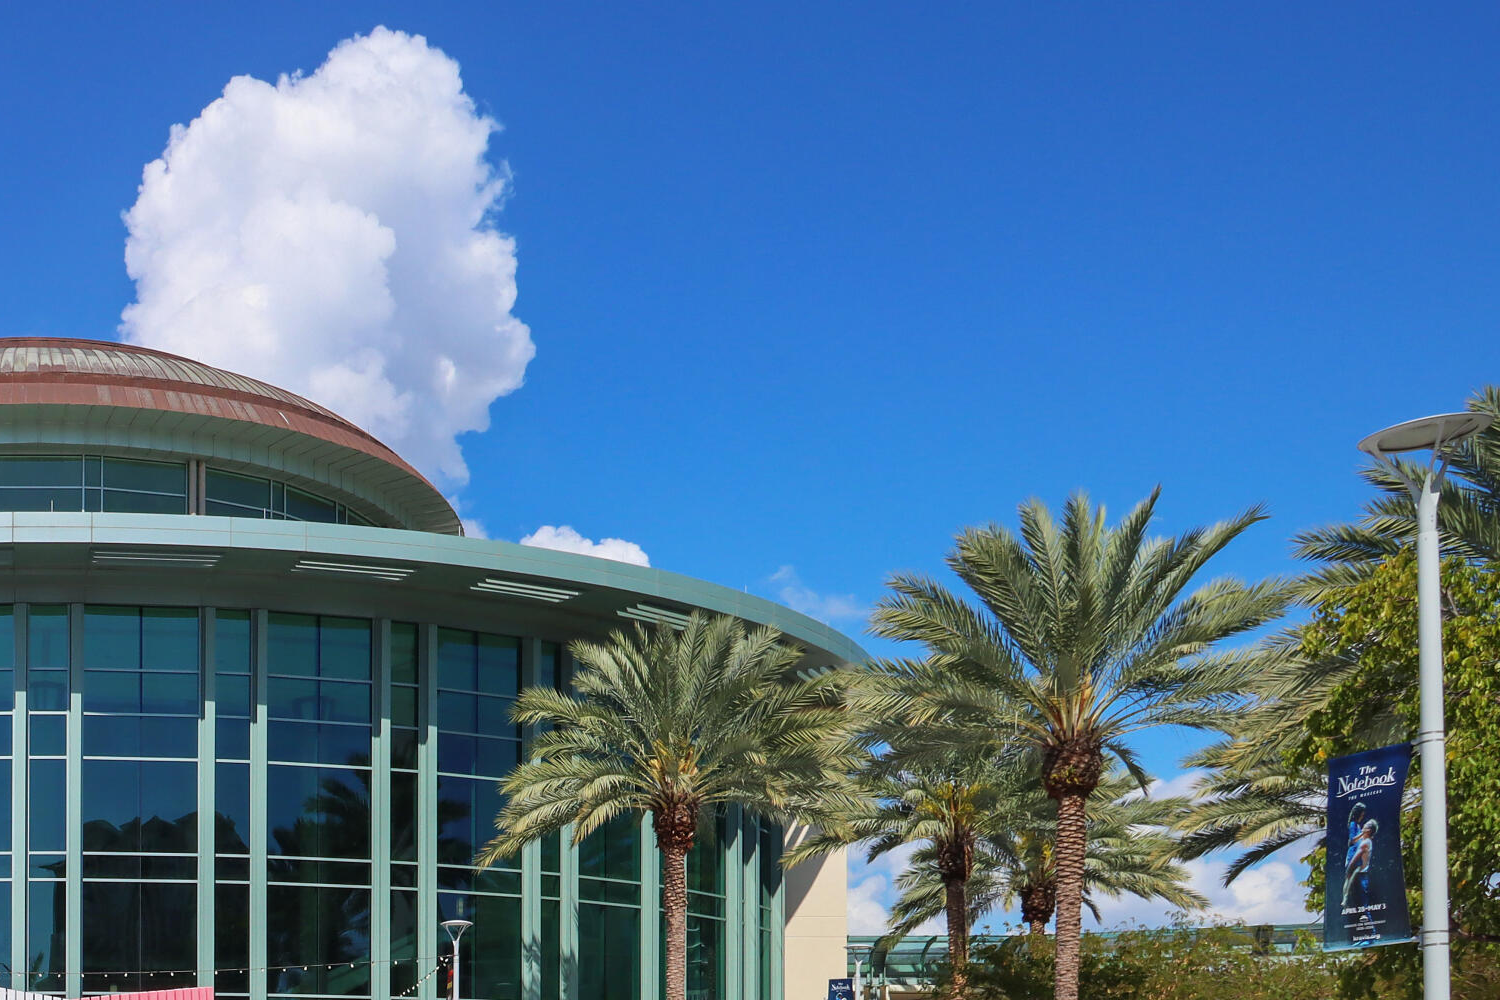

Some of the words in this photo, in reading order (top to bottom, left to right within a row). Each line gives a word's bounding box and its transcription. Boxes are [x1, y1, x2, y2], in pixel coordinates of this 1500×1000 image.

[1359, 765, 1377, 776] The
[1336, 766, 1396, 795] Notebook
[1341, 907, 1357, 915] APRIL
